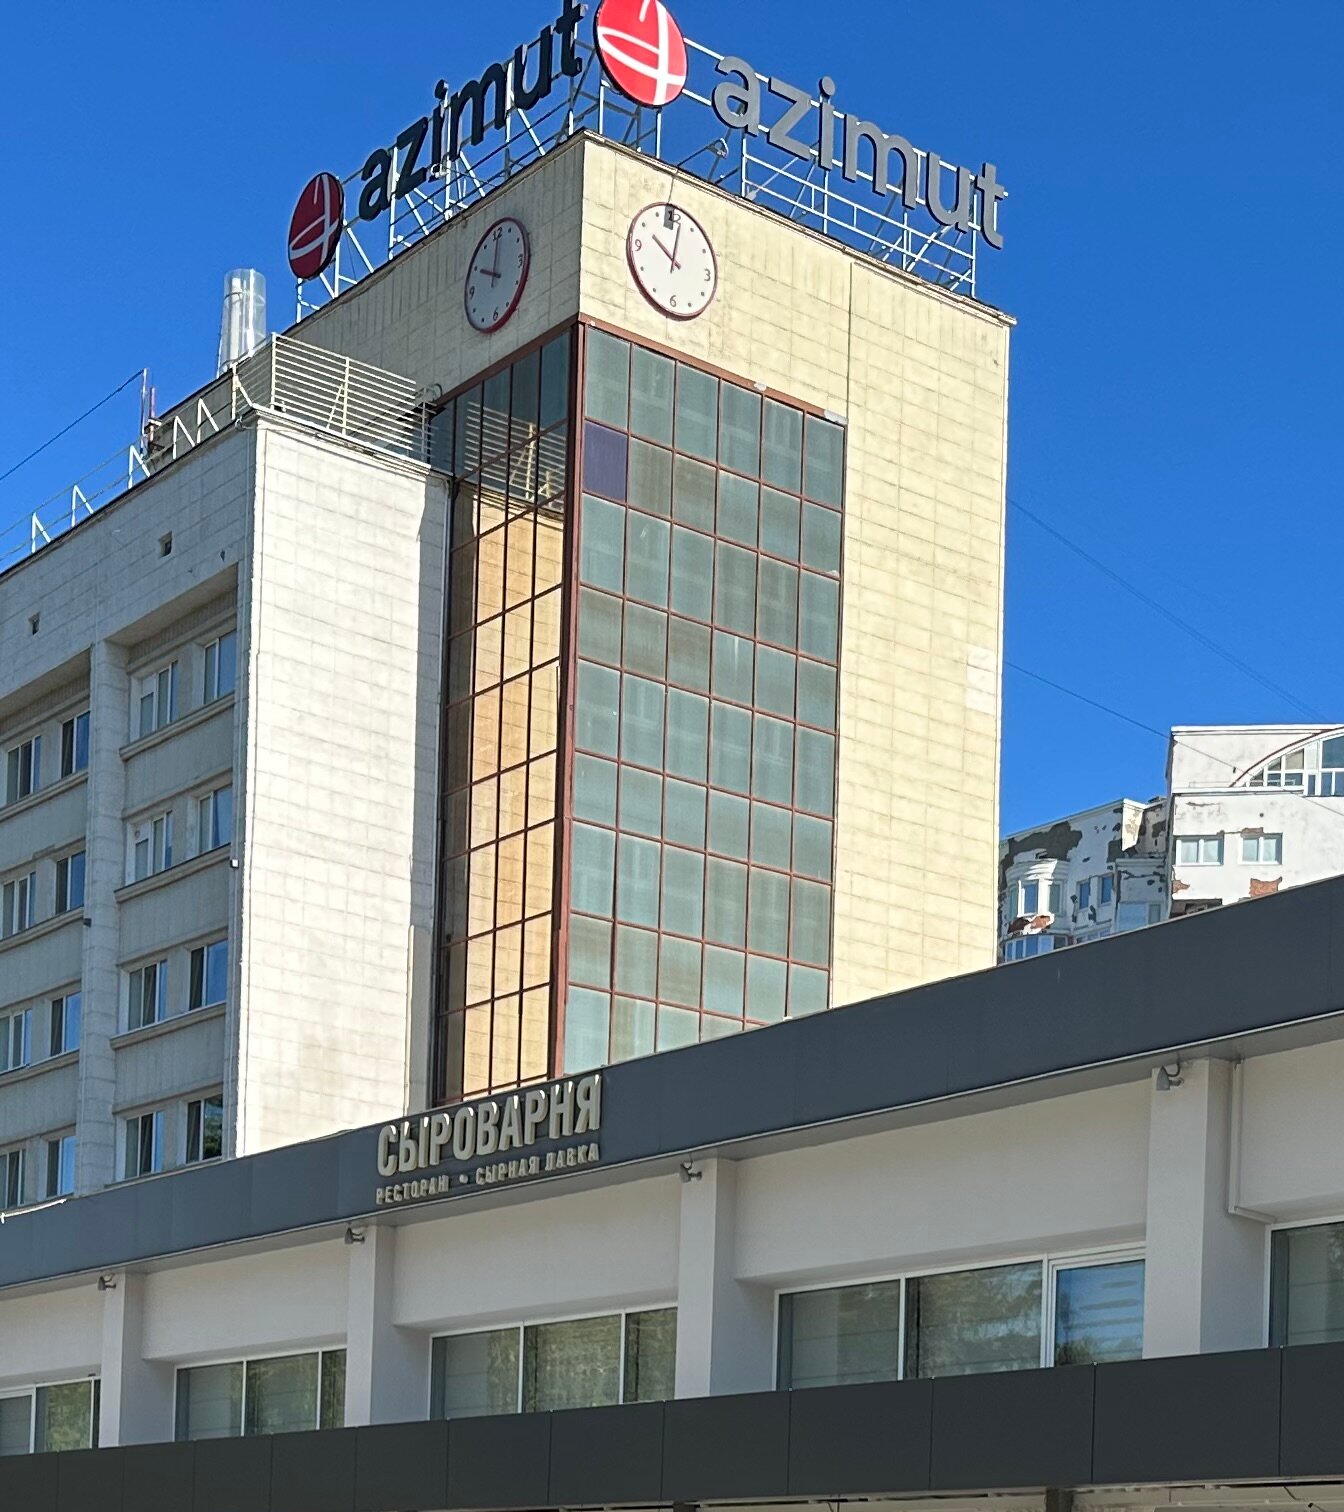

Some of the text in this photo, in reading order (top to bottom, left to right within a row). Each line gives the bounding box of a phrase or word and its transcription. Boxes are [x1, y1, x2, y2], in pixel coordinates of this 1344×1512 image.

[359, 0, 585, 222] azimut
[712, 55, 1007, 250] azimut
[492, 227, 503, 242] 12
[634, 238, 642, 252] 9
[704, 269, 711, 282] 3
[670, 295, 677, 308] 6
[492, 307, 499, 321] 6
[377, 1074, 602, 1177] СЫРОВАРНЯ
[376, 1143, 599, 1205] РЕСТОРАН СЫРНАЯ ЛАВКА
